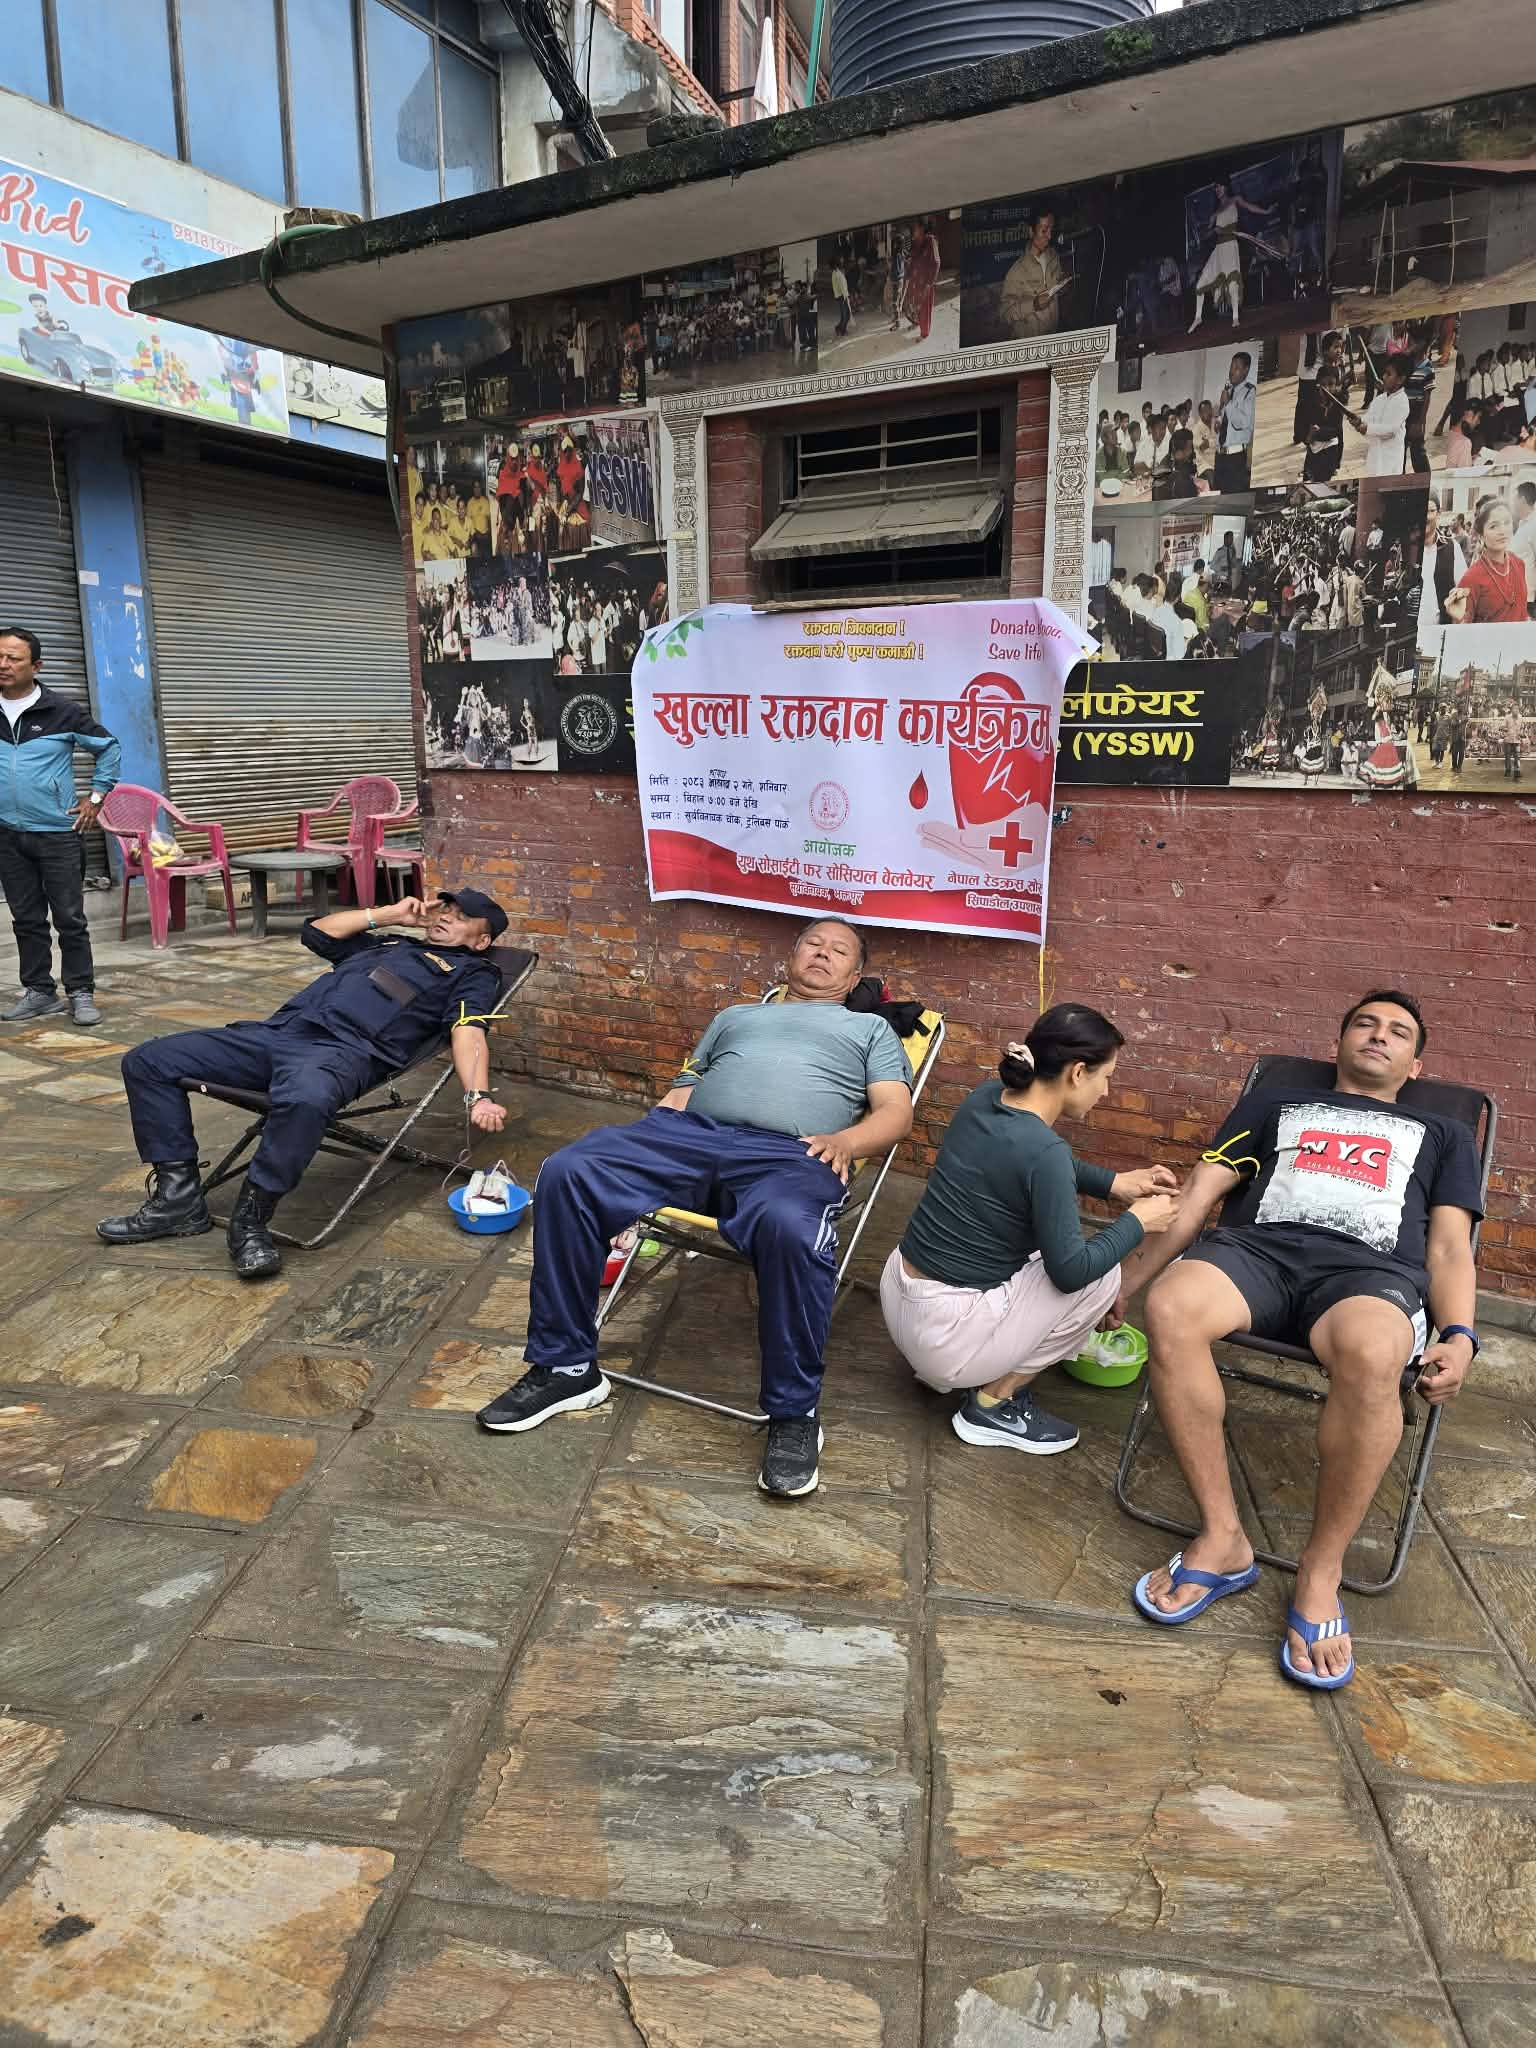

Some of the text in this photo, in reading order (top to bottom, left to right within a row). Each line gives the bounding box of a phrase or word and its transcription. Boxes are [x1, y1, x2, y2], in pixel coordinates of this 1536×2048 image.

[0, 175, 89, 243] Kid
[990, 618, 1035, 635] Donate
[784, 644, 822, 659] रक्तदान
[988, 642, 1021, 660] Save
[652, 692, 751, 748] खुल्ला
[760, 694, 888, 748] रक्तदान
[1072, 731, 1195, 762] (YSSW)
[649, 775, 669, 786] मिति
[650, 794, 670, 804] समय
[803, 838, 857, 857] आयोजक
[804, 862, 823, 880] फर
[947, 870, 980, 886] नेपाल
